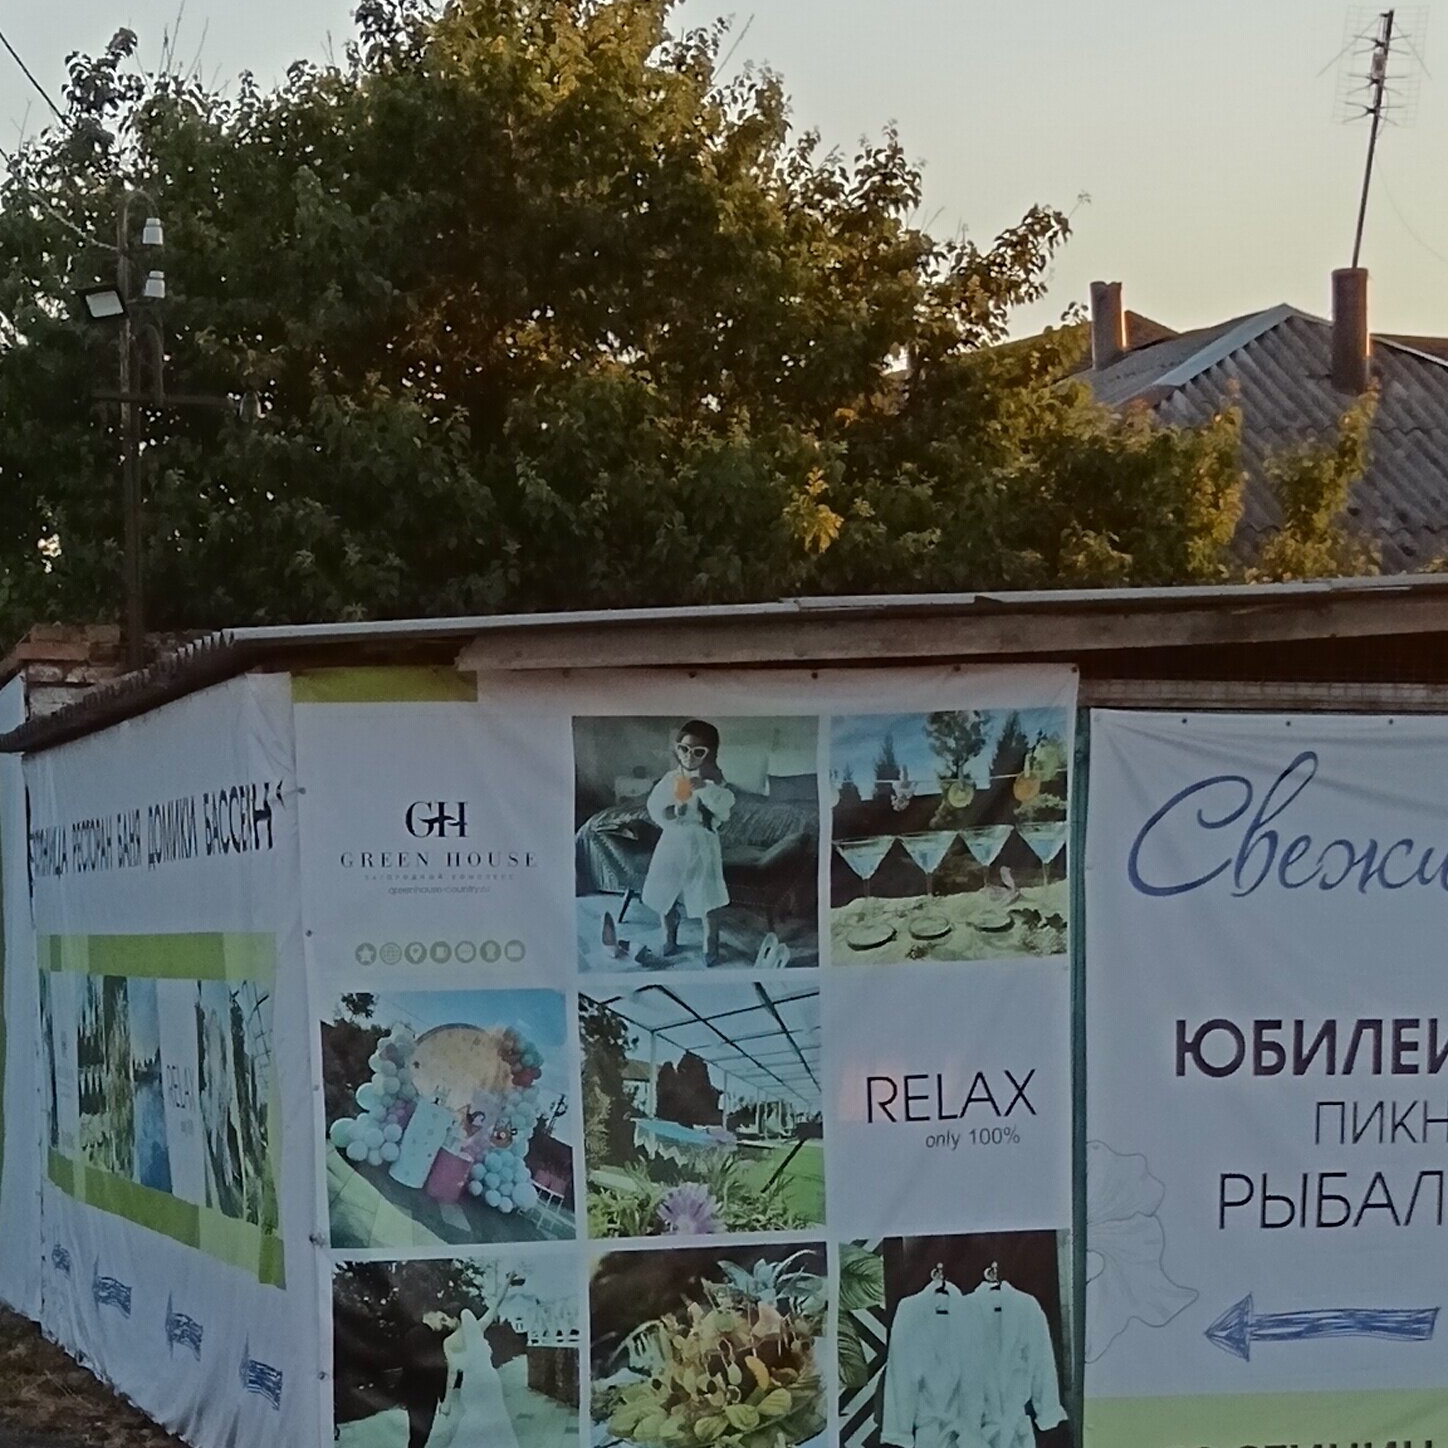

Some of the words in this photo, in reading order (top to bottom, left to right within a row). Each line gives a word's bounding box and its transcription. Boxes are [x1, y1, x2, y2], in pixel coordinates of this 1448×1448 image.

[147, 796, 198, 871] ДОМИКИ
[340, 851, 430, 869] GREEN
[446, 851, 538, 869] HOUSE
[864, 1067, 1038, 1126] RELAX
[925, 1124, 963, 1152] only
[968, 1124, 1022, 1149] 100%
